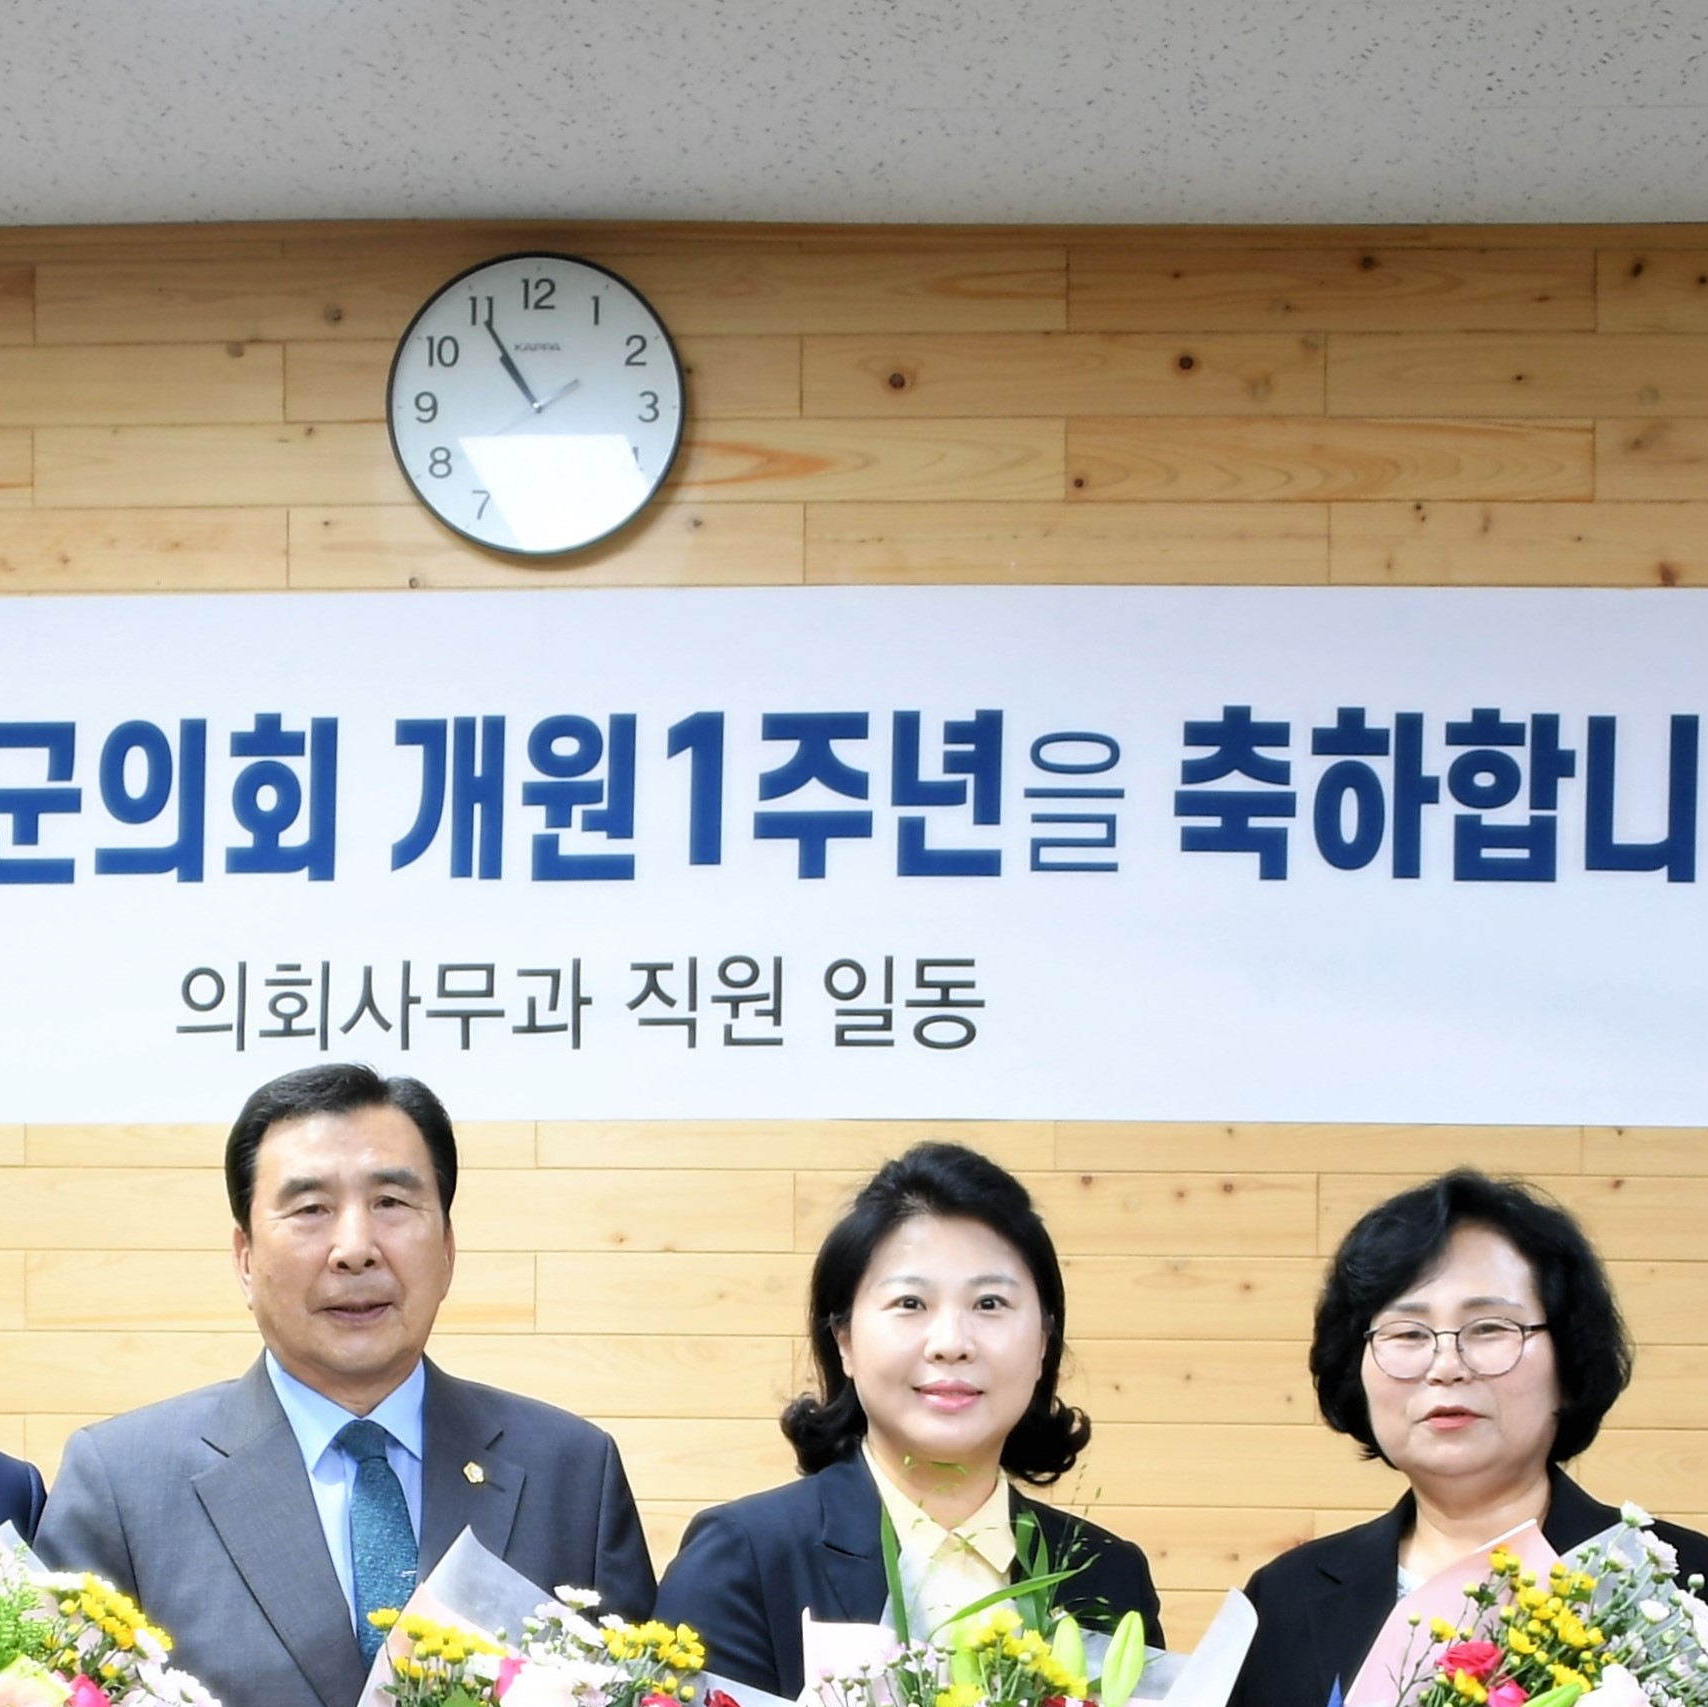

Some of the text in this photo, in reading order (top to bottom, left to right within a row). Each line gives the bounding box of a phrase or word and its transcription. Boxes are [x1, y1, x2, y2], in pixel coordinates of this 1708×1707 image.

[521, 277, 557, 310] 12
[468, 296, 494, 326] 11
[591, 295, 601, 326] 1
[425, 335, 460, 368] 10
[624, 334, 648, 366] 2
[414, 391, 439, 424] 9
[637, 390, 660, 423] 3
[428, 446, 453, 479] 8
[471, 489, 491, 520] 7
[391, 709, 1125, 882] 개원1주년을
[176, 955, 985, 1052] 의회사무과 직원 일동
